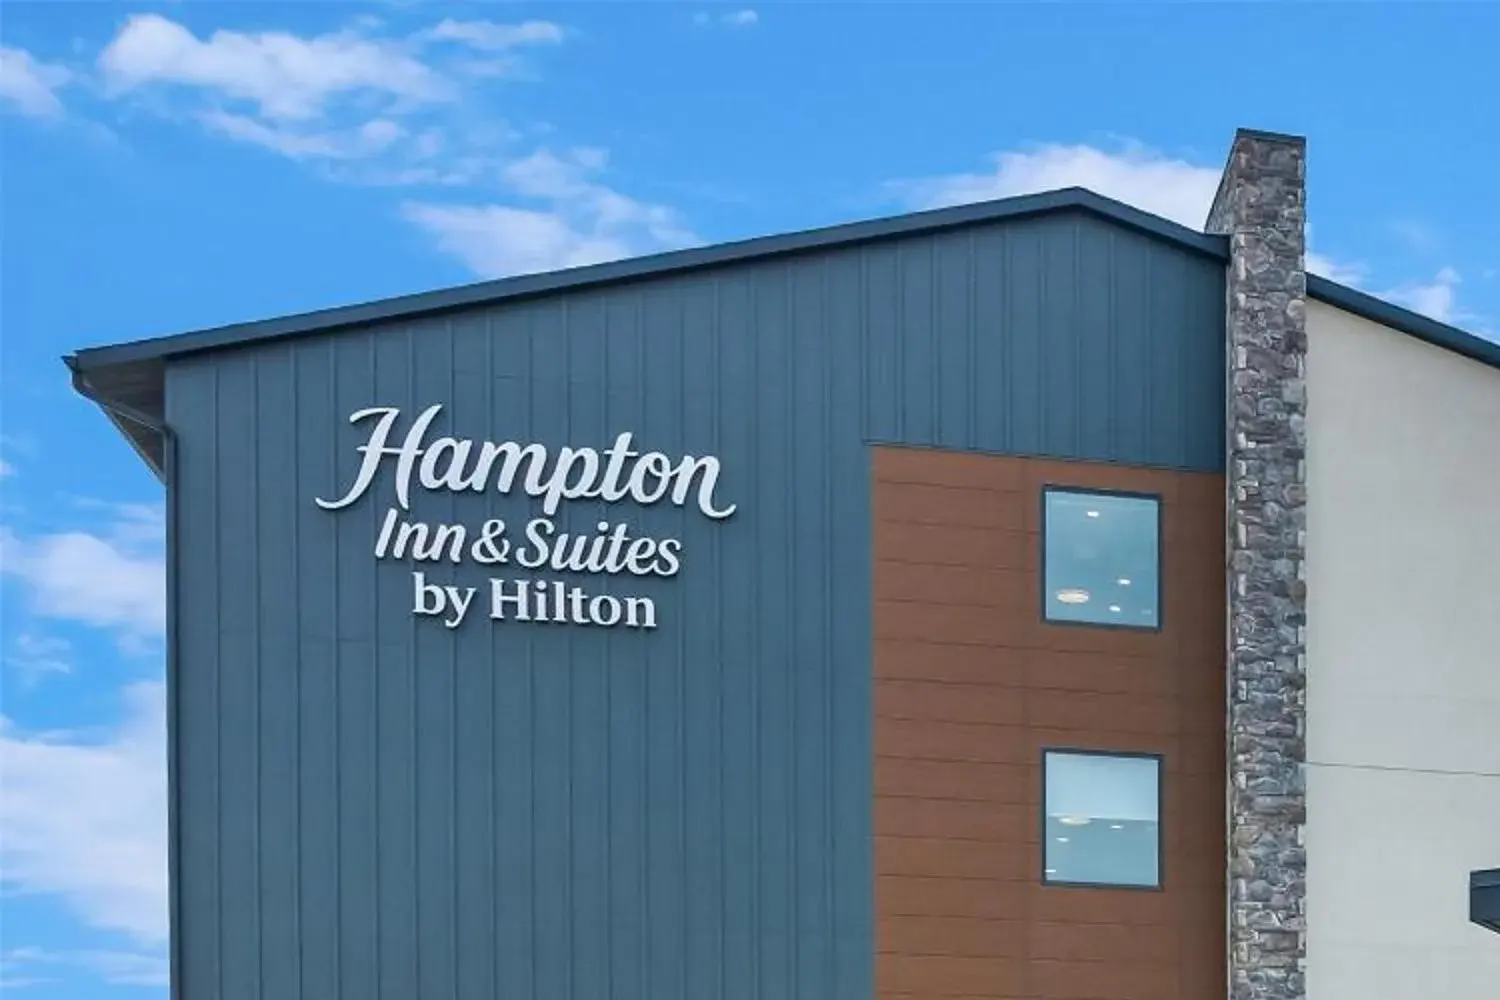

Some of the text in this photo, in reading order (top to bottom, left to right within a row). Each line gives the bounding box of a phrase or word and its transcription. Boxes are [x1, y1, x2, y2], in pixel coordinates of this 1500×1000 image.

[315, 403, 737, 519] Hampton
[375, 508, 466, 563] Inn
[516, 519, 682, 576] Suites
[412, 572, 657, 628] by Hilton
